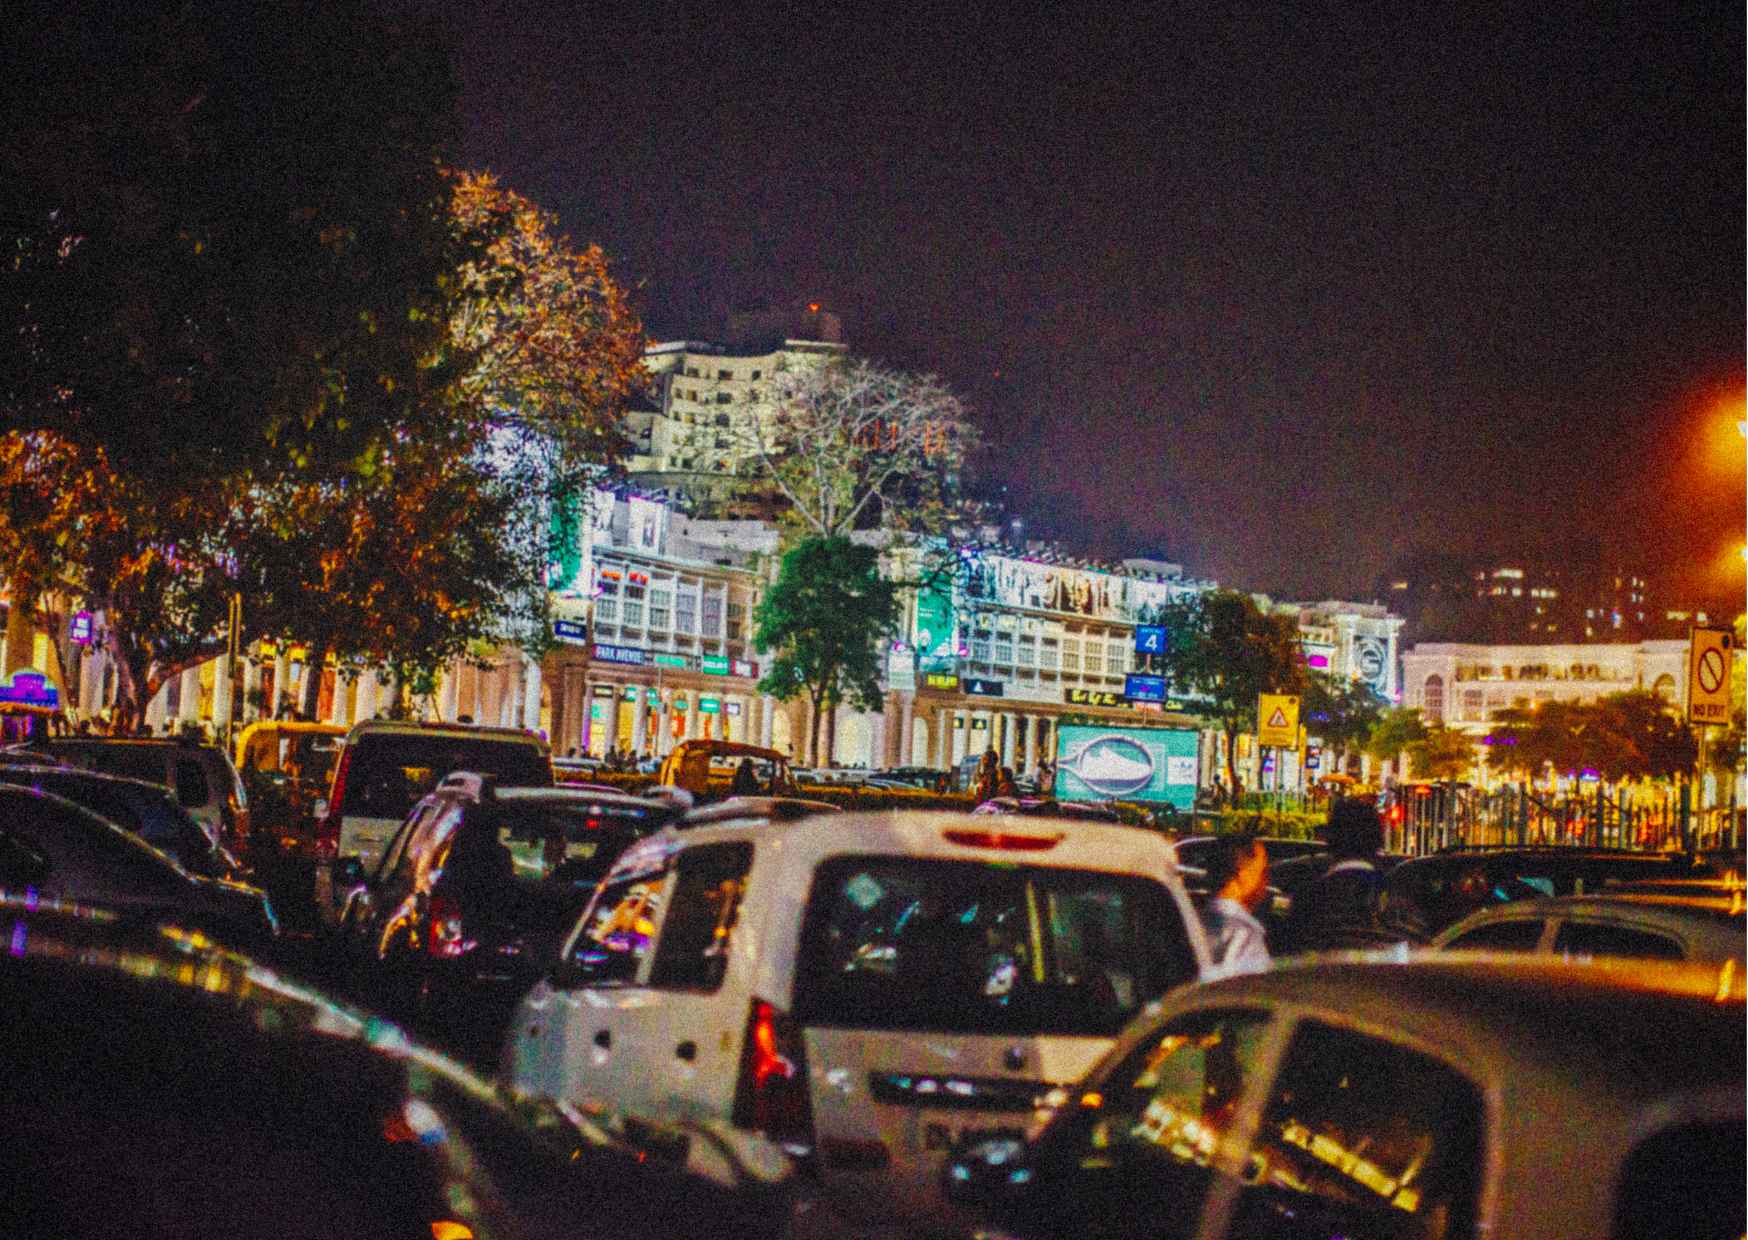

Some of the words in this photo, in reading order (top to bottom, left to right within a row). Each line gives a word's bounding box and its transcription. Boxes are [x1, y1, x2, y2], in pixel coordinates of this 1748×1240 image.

[1145, 634, 1158, 651] 4
[596, 645, 614, 660] PARK
[615, 647, 641, 664] AVENUE
[1694, 704, 1705, 716] NO
[1707, 704, 1725, 717] EXIT
